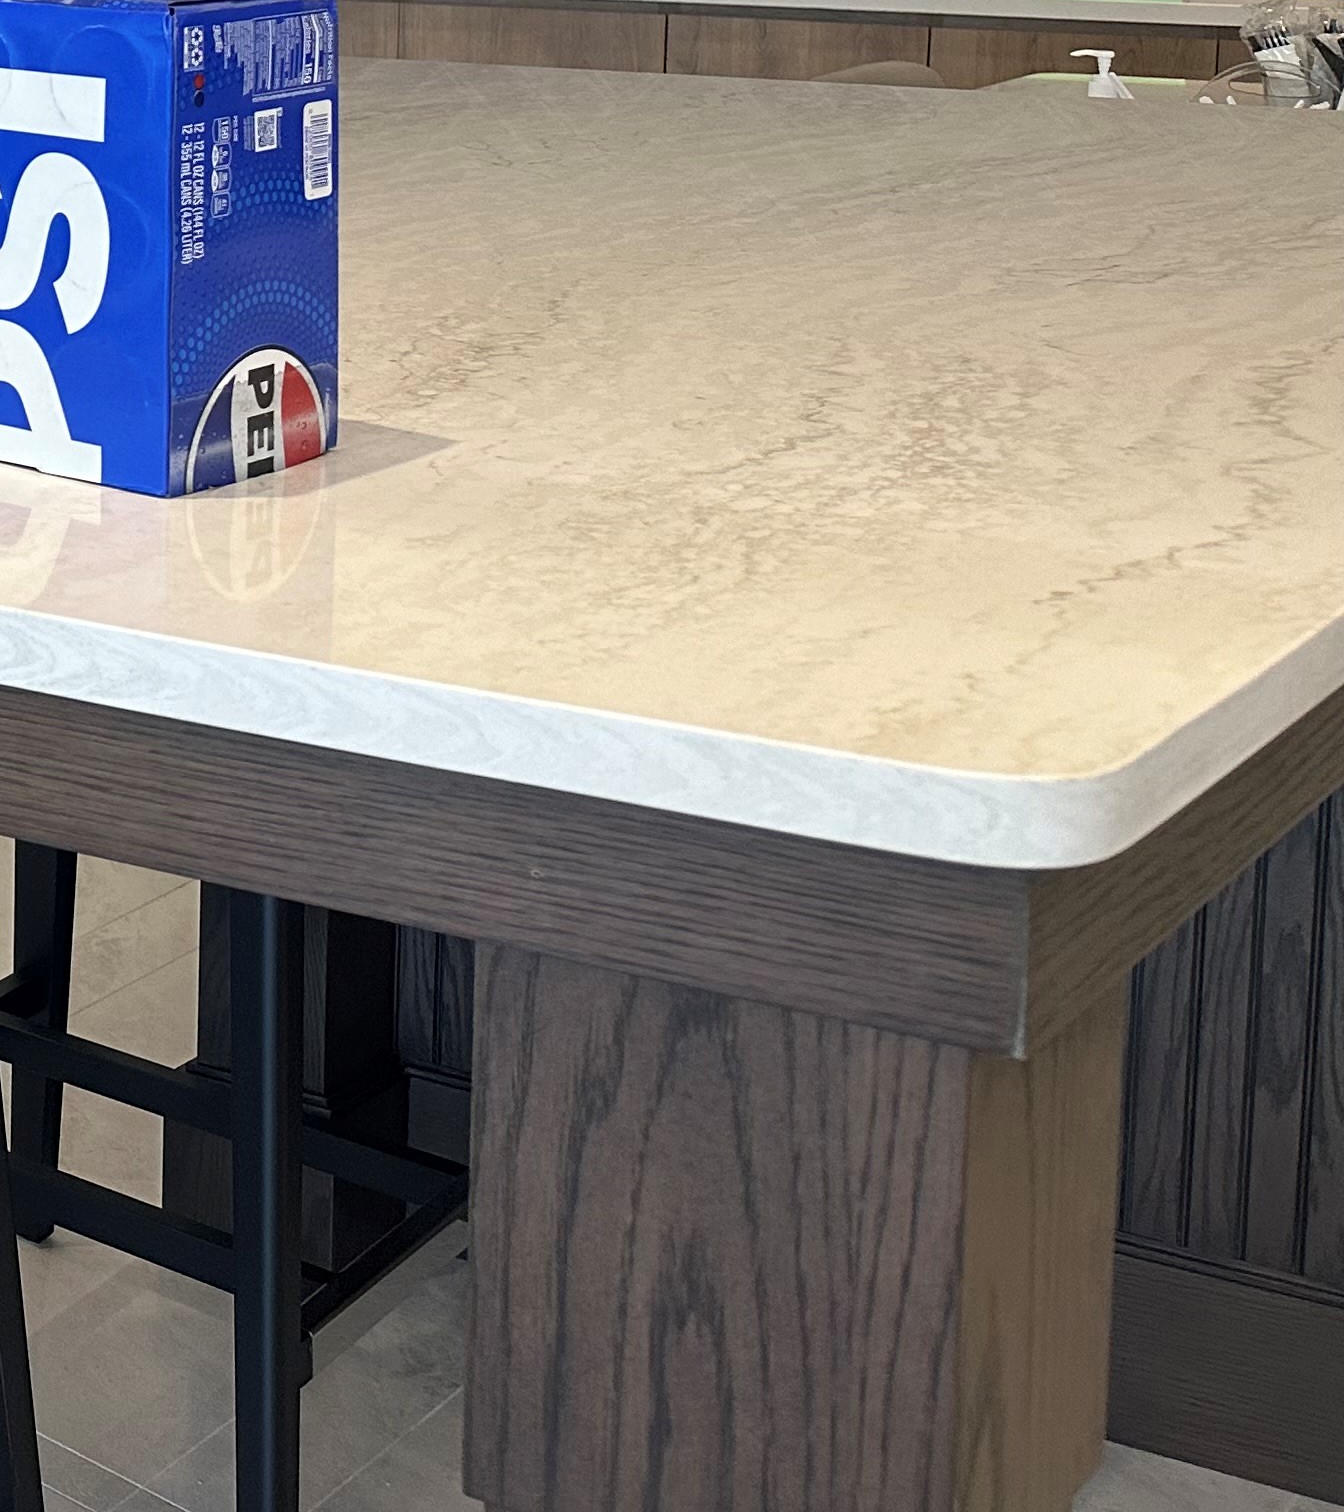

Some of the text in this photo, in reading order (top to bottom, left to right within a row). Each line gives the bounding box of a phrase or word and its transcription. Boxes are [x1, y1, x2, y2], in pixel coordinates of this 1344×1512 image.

[181, 123, 193, 135] 12
[193, 122, 205, 134] 12
[180, 141, 192, 161] 355
[193, 141, 205, 150] 12
[193, 151, 205, 165] FL
[180, 162, 192, 179] mL
[193, 165, 204, 178] OZ
[180, 179, 192, 206] CANS
[192, 179, 204, 206] CANS
[192, 206, 204, 228] (144
[193, 228, 204, 241] FL
[193, 241, 205, 259] OZ)
